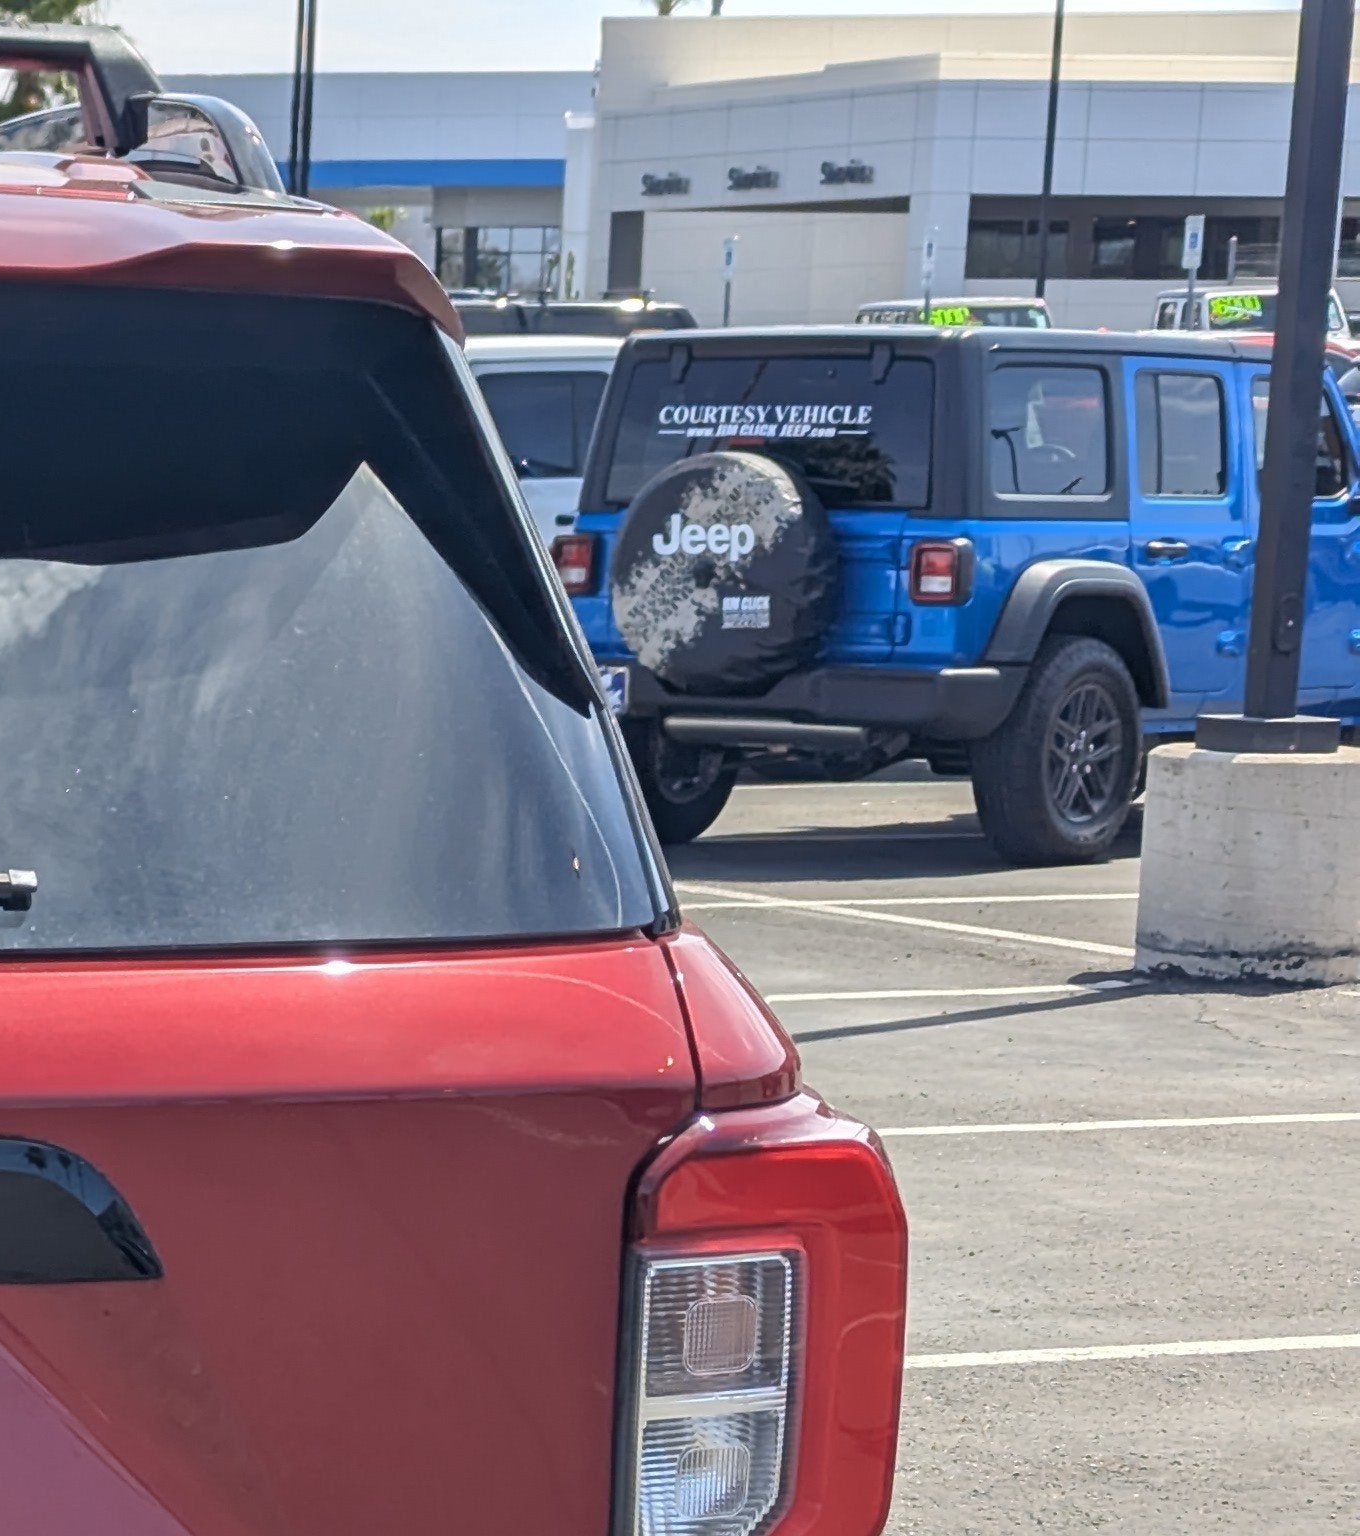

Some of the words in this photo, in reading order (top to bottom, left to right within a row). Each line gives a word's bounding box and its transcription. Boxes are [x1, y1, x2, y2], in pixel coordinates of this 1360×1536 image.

[658, 404, 770, 424] COURTESY
[775, 404, 872, 424] VEHICLE
[652, 512, 755, 562] Jeep
